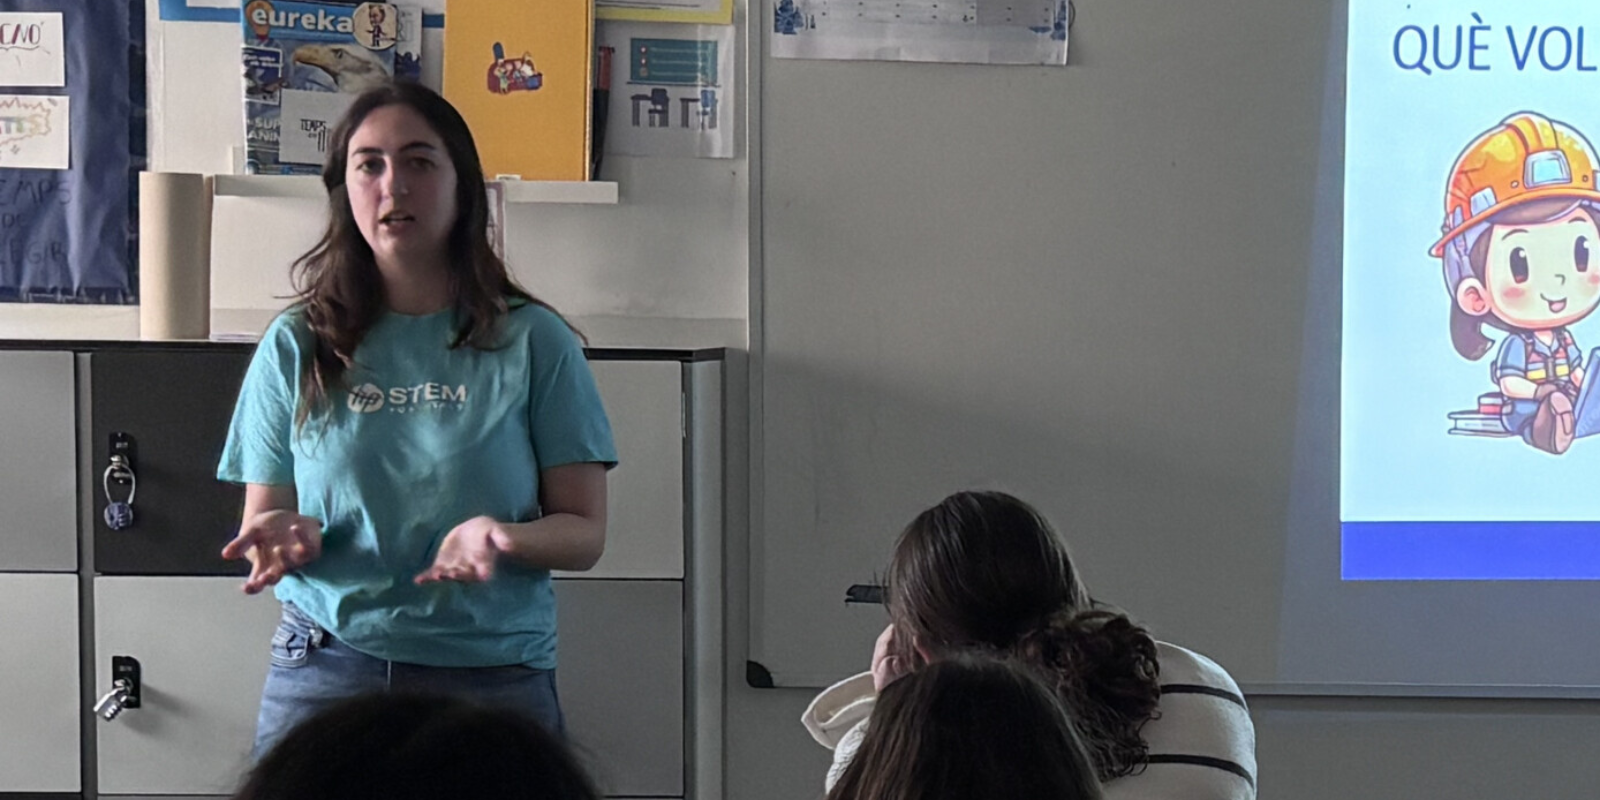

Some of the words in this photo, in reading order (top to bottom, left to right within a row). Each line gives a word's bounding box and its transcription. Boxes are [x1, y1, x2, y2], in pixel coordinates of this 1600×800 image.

[252, 8, 354, 33] eureka
[1393, 12, 1492, 76] QUÈ
[1505, 25, 1598, 71] VOL
[347, 383, 385, 413] hp
[389, 382, 467, 404] STEM
